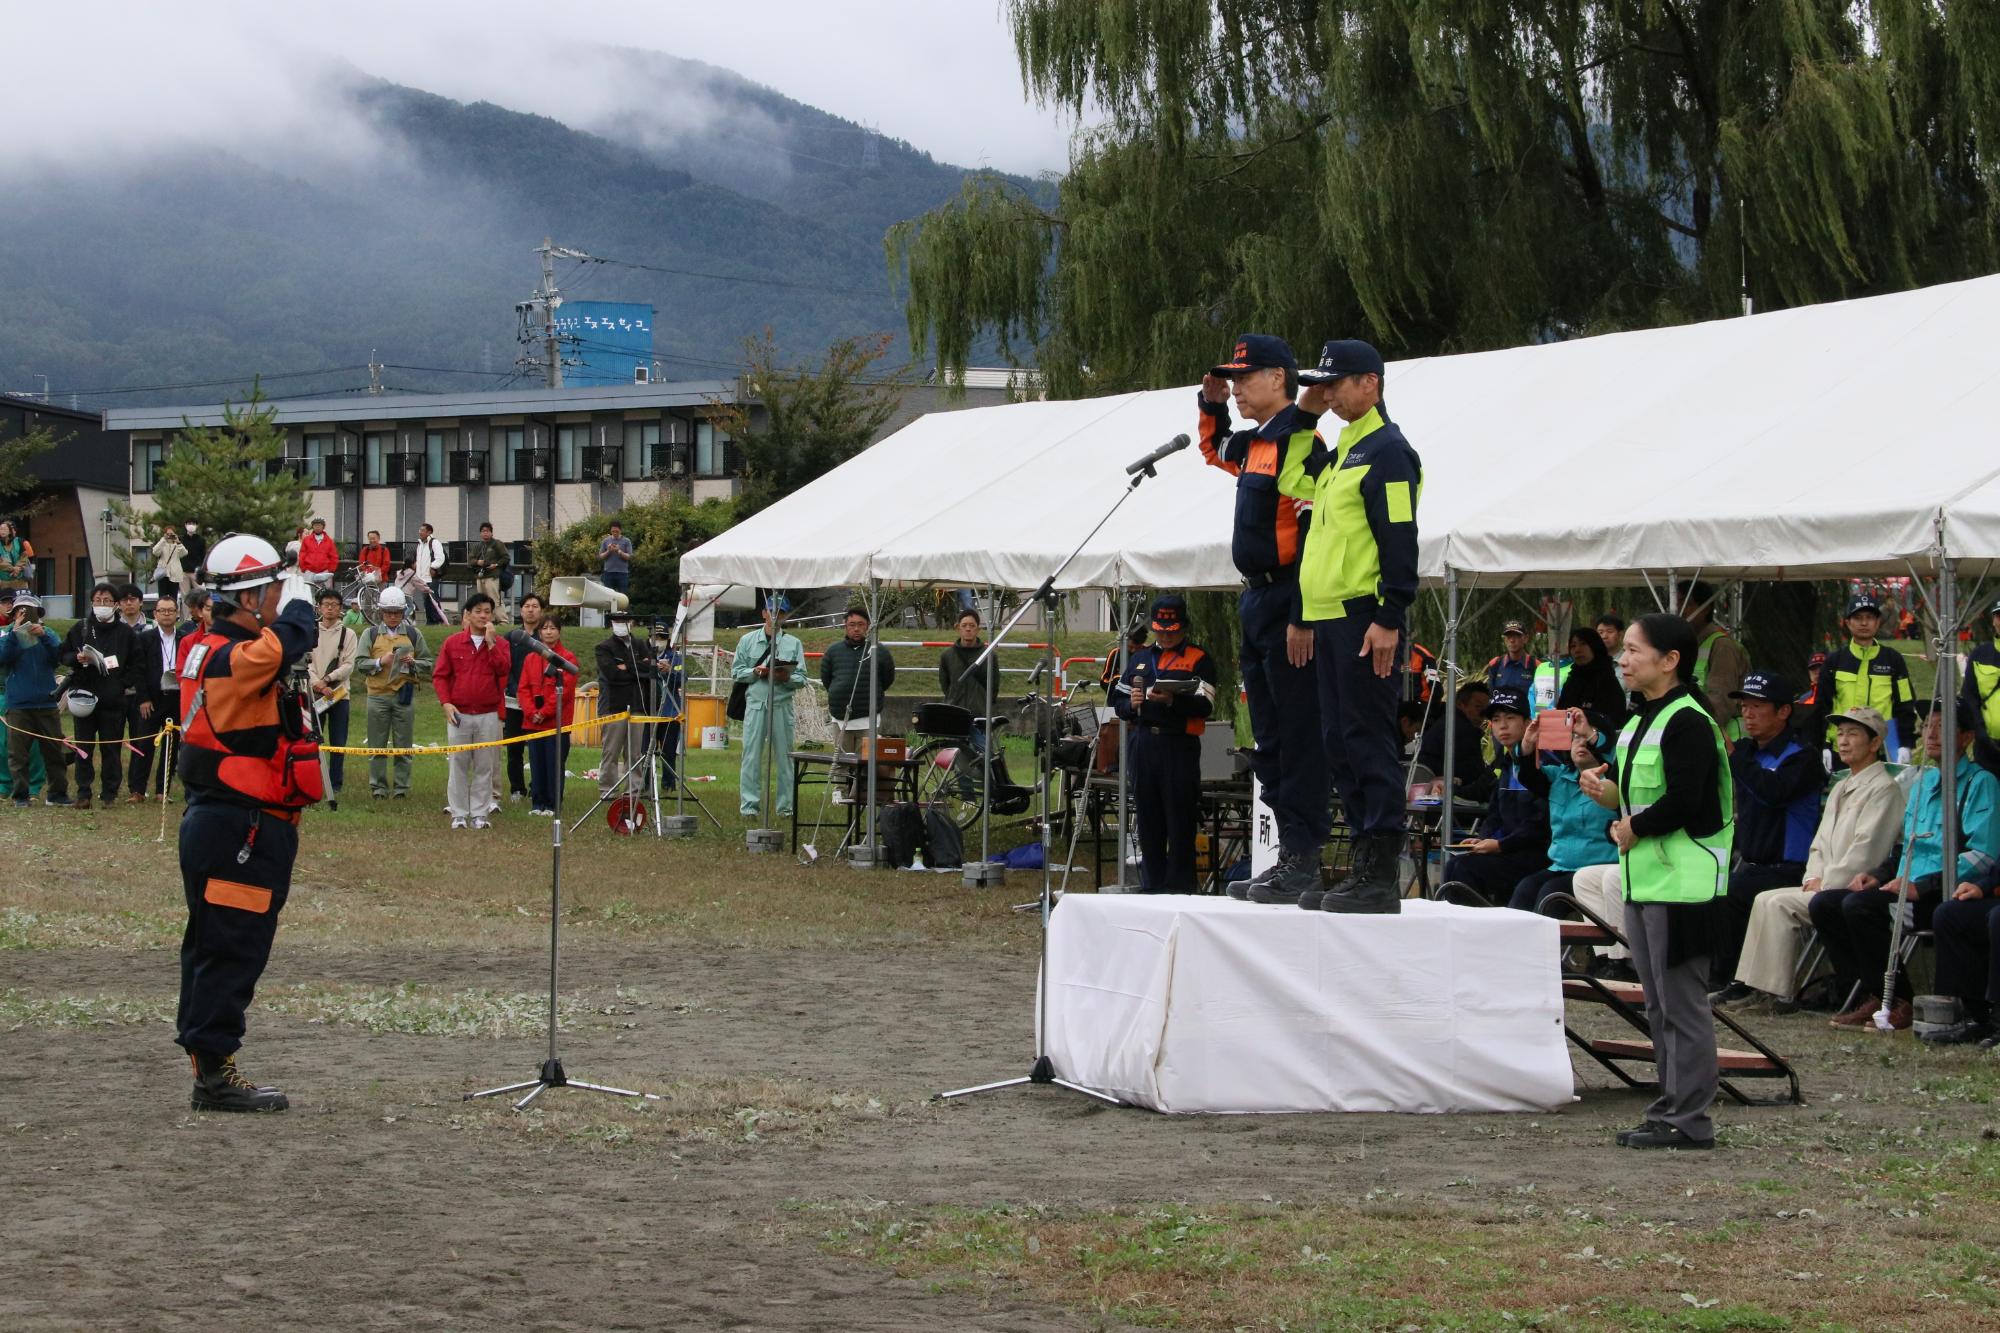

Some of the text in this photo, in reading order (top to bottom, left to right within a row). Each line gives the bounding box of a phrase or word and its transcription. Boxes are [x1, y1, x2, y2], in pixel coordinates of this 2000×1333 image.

[584, 316, 650, 332] エヌエスセイコー
